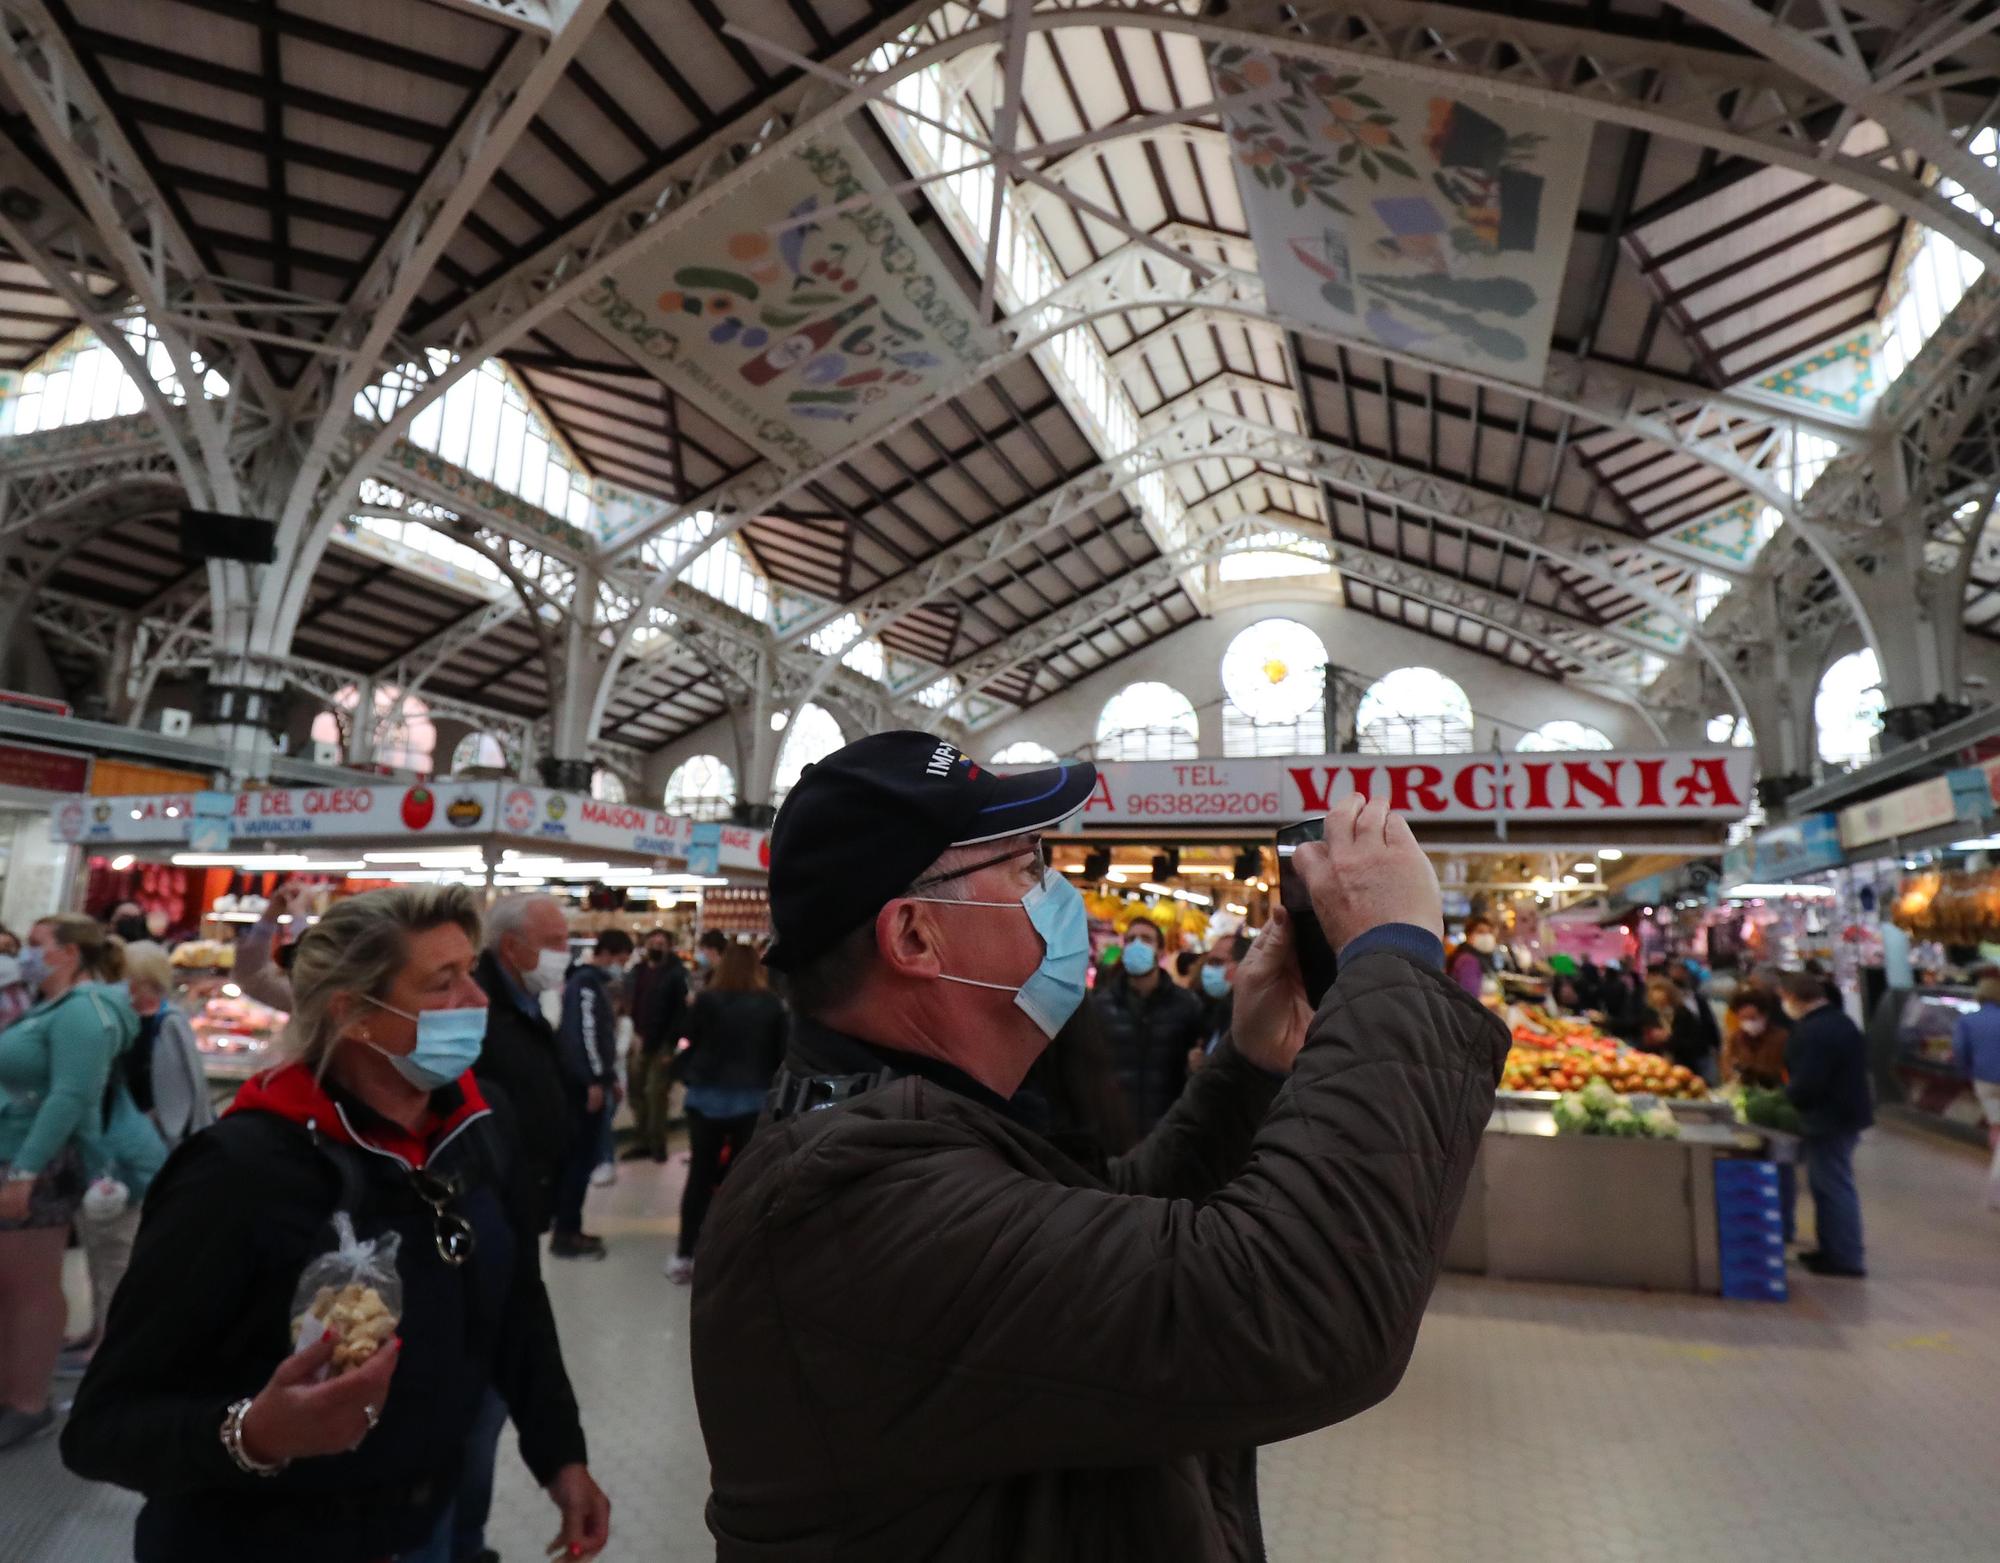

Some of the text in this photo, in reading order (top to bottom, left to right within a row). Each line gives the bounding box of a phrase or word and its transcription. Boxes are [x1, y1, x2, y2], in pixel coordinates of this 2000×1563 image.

[1173, 766, 1229, 786] TEL:
[1288, 757, 1744, 812] VIRGINIA
[260, 789, 293, 816] DEL
[303, 788, 374, 814] QUESO
[581, 800, 646, 831] MAISON
[1127, 791, 1279, 816] 963829206
